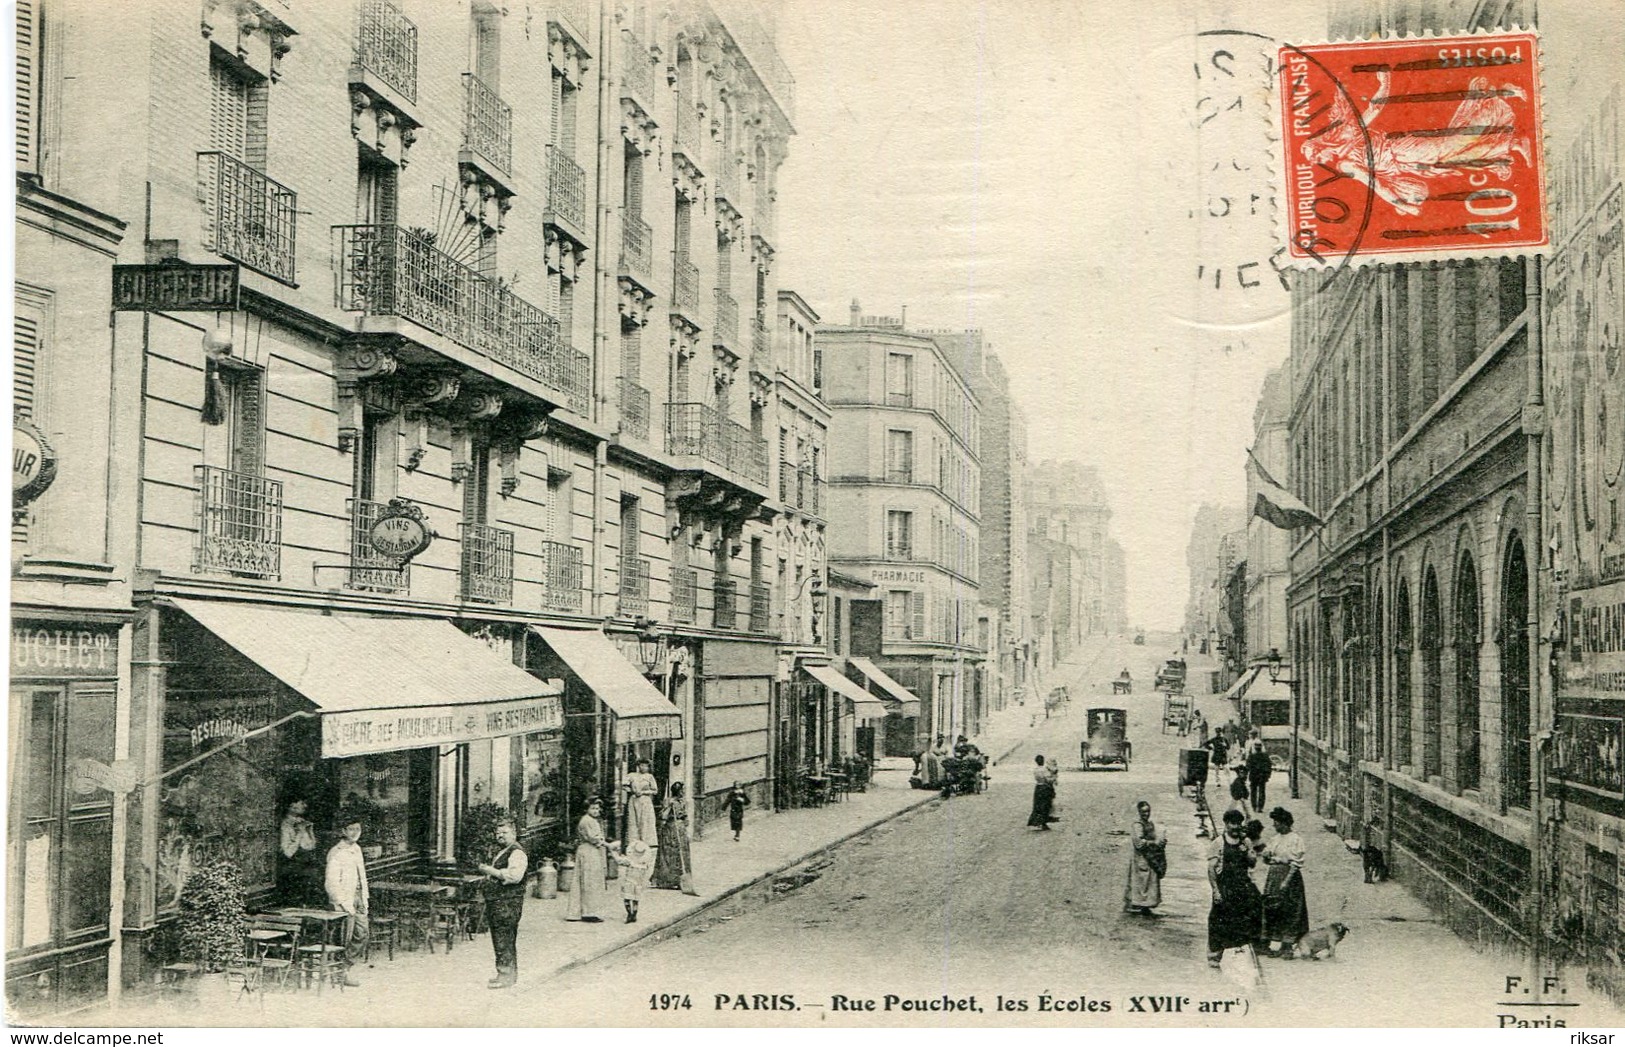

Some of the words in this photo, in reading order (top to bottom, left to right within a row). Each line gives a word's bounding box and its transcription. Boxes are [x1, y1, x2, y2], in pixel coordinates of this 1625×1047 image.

[1438, 46, 1522, 67] POSTES
[119, 268, 234, 305] COIFFEUR
[384, 520, 410, 532] VINS
[375, 536, 420, 553] RESTAURANT
[871, 569, 925, 583] PHARMACIE
[1570, 597, 1625, 662] ENGLAN
